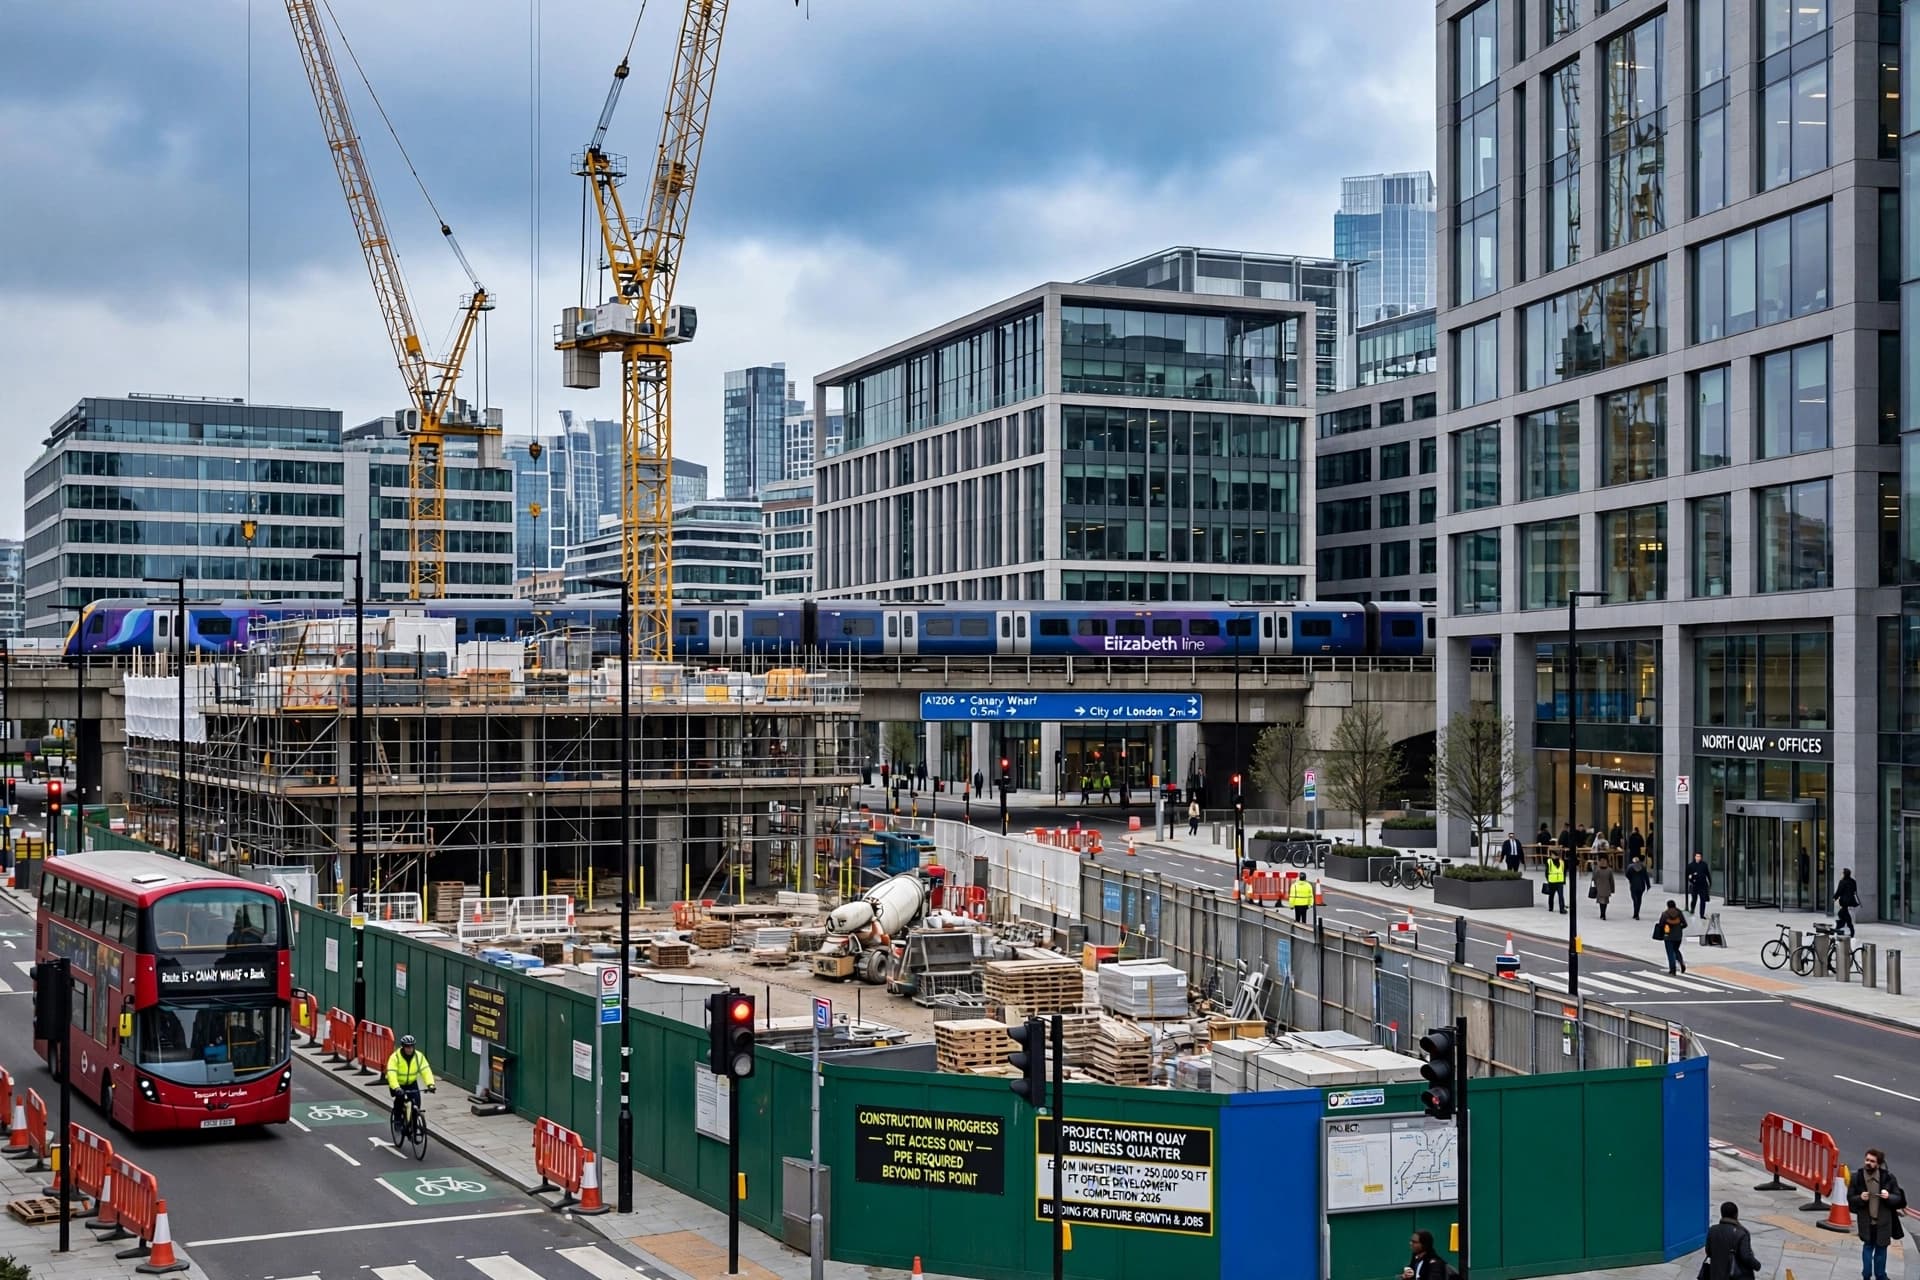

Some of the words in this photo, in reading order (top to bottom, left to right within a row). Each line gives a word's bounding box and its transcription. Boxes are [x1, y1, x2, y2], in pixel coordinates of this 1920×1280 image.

[1182, 637, 1205, 651] line
[925, 695, 956, 705] A1206
[970, 695, 1004, 708] Canary
[1089, 706, 1110, 719] City
[1112, 706, 1123, 716] of
[1126, 706, 1163, 716] London
[1168, 707, 1186, 717] 2mi
[1702, 734, 1734, 749] NORTH
[1737, 735, 1765, 752] QUAY
[1777, 736, 1822, 753] OFFICES
[860, 1111, 932, 1130] CONSTRUCTION
[934, 1117, 945, 1131] IN
[947, 1118, 999, 1136] PROGRESS
[885, 1133, 906, 1147] SITE
[908, 1135, 946, 1150] ACCESS
[948, 1139, 974, 1152] ONLY
[1062, 1125, 1112, 1140] PROJECT:
[1115, 1129, 1153, 1144] NORTH
[1155, 1133, 1187, 1146] QUAY
[894, 1150, 913, 1164] PPE
[915, 1152, 964, 1169] REQUIRED
[1069, 1141, 1124, 1156] BUSINESS
[1126, 1146, 1181, 1161] QUARTER
[882, 1165, 921, 1180] BEYOND
[923, 1169, 946, 1183] THIS
[948, 1171, 978, 1185] POINT
[1068, 1173, 1078, 1183] FT
[1181, 1170, 1193, 1182] SQ
[1195, 1171, 1207, 1182] FT
[1082, 1207, 1099, 1219] FOR
[1101, 1208, 1133, 1222] FUTURE
[1134, 1211, 1172, 1225] GROWTH
[1182, 1215, 1204, 1227] JOBS
